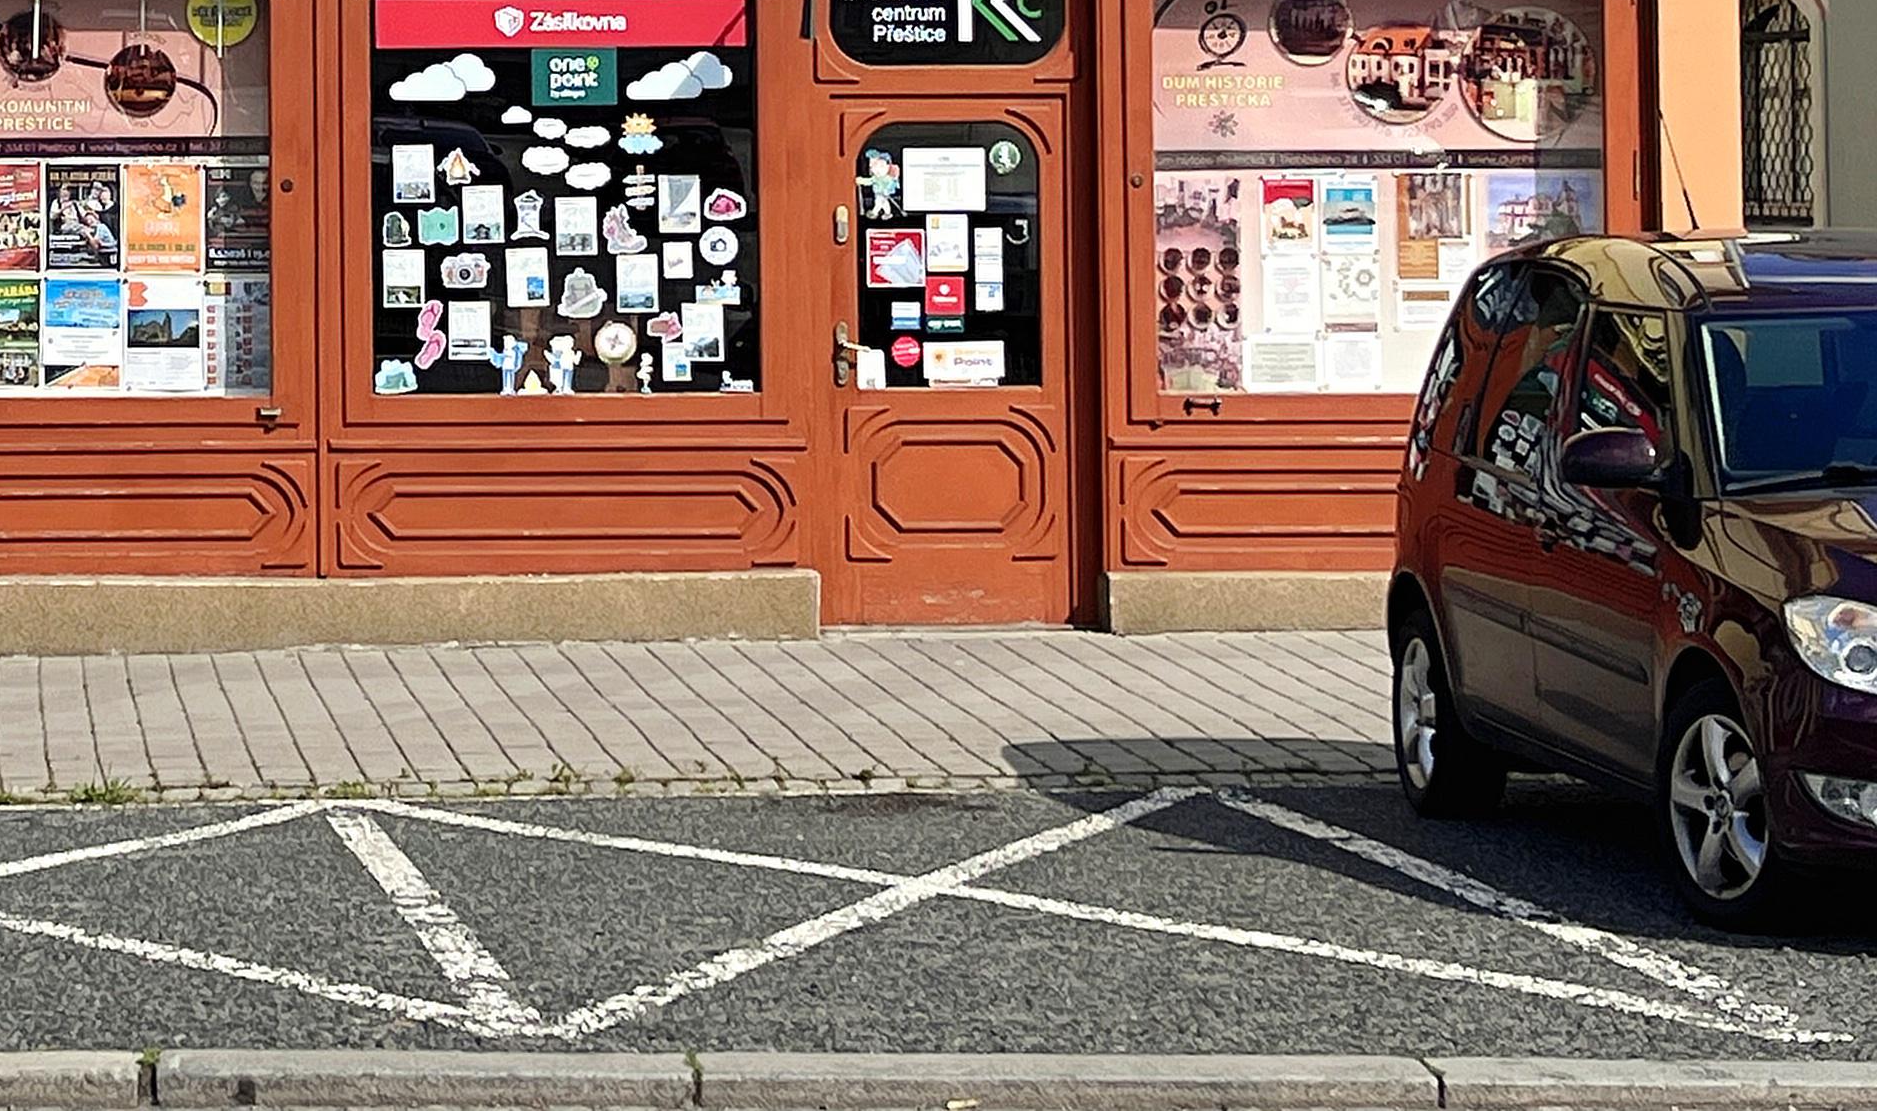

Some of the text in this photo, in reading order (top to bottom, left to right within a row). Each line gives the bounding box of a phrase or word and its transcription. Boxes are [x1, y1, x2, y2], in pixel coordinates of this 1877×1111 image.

[529, 11, 627, 32] Zásilkovna
[871, 5, 947, 22] centrum
[873, 24, 947, 43] Přeštice
[549, 57, 586, 72] one
[550, 71, 599, 89] point
[1205, 75, 1284, 89] HISTORIE
